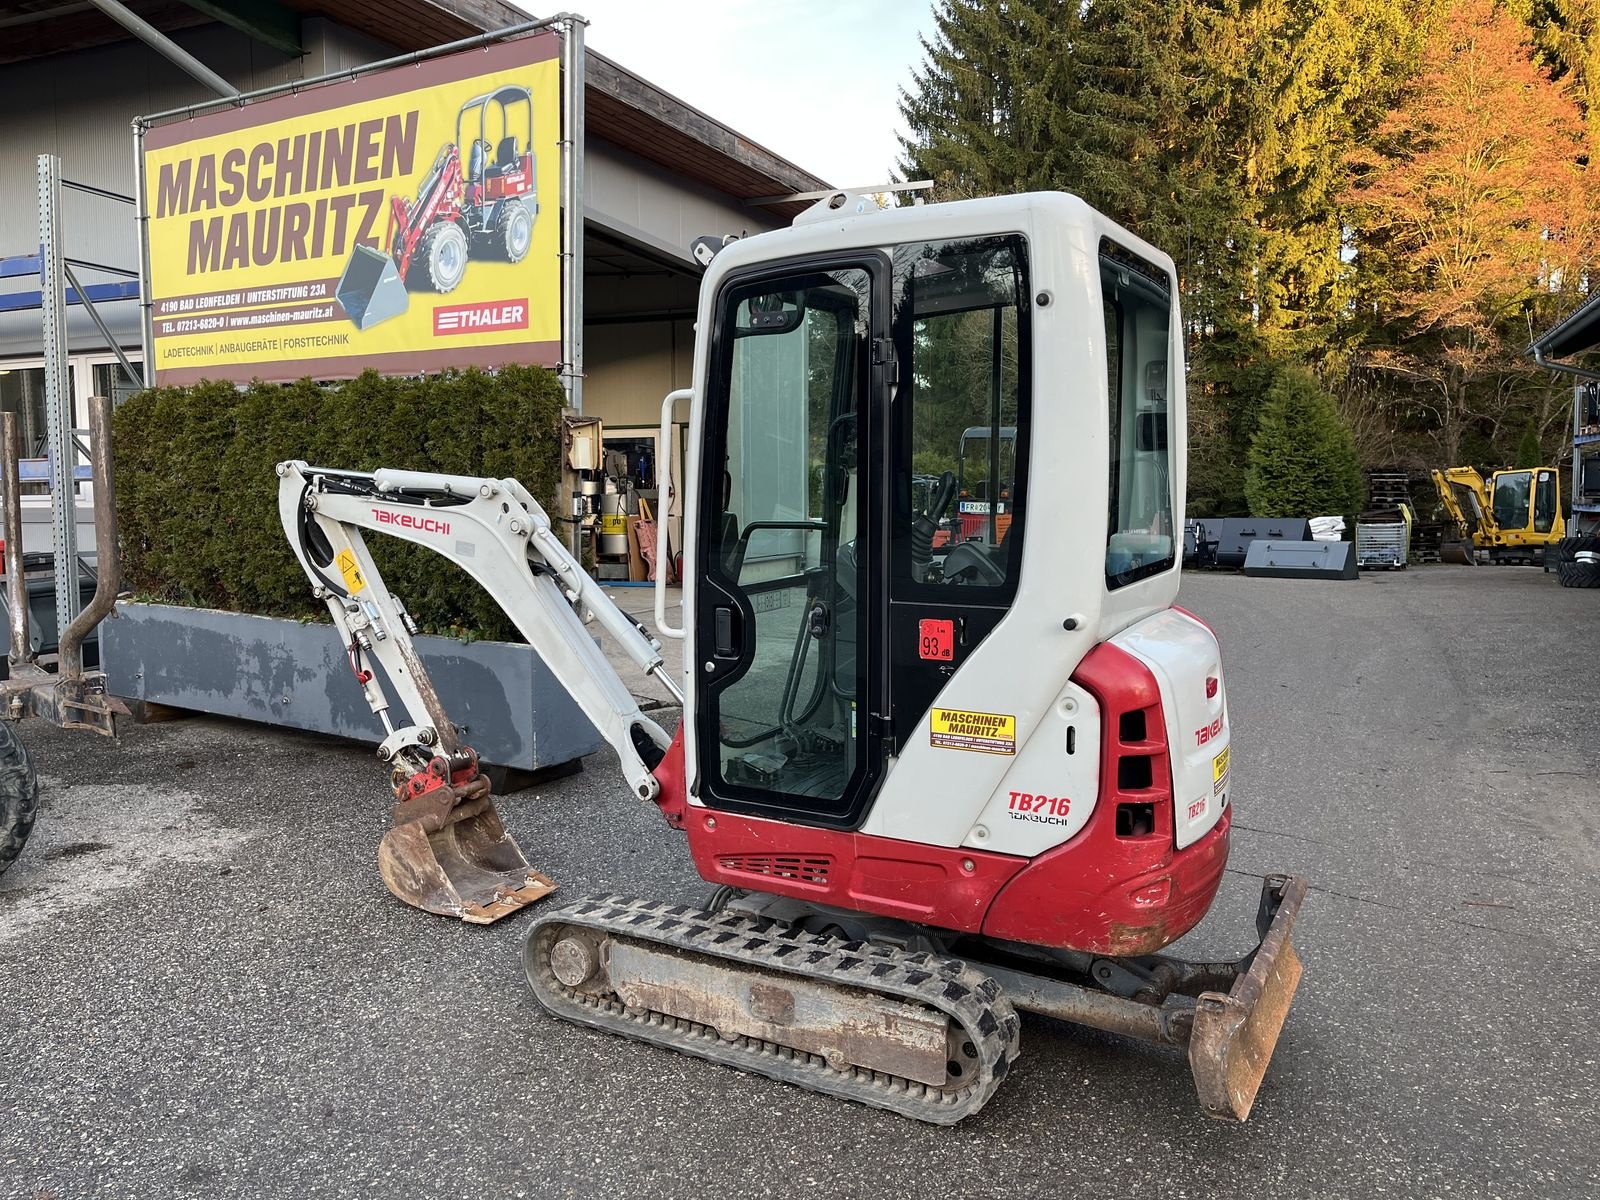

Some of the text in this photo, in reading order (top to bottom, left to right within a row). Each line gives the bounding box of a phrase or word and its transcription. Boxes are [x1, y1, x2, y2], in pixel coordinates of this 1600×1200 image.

[156, 110, 419, 219] MASCHINEN
[186, 189, 384, 275] MAURITZ
[161, 284, 326, 312] 4190 BAD LEONFELDEN UNTERSTIFTUNG 23A
[162, 306, 333, 333] TEL. 07213-6820-0 www.maschinen-mauritz.at
[459, 305, 524, 328] THALER
[163, 333, 349, 359] LADETECHNIK ANBAUGERÄTE FORSTTECHNIK
[371, 509, 450, 535] TAKEUCHI
[923, 636, 939, 656] 93
[940, 712, 1007, 728] MASCHINEN
[948, 723, 999, 737] MAURITZ
[1009, 792, 1070, 816] TB216
[1188, 799, 1205, 820] TB216
[1008, 812, 1067, 826] TAKEUCHI
